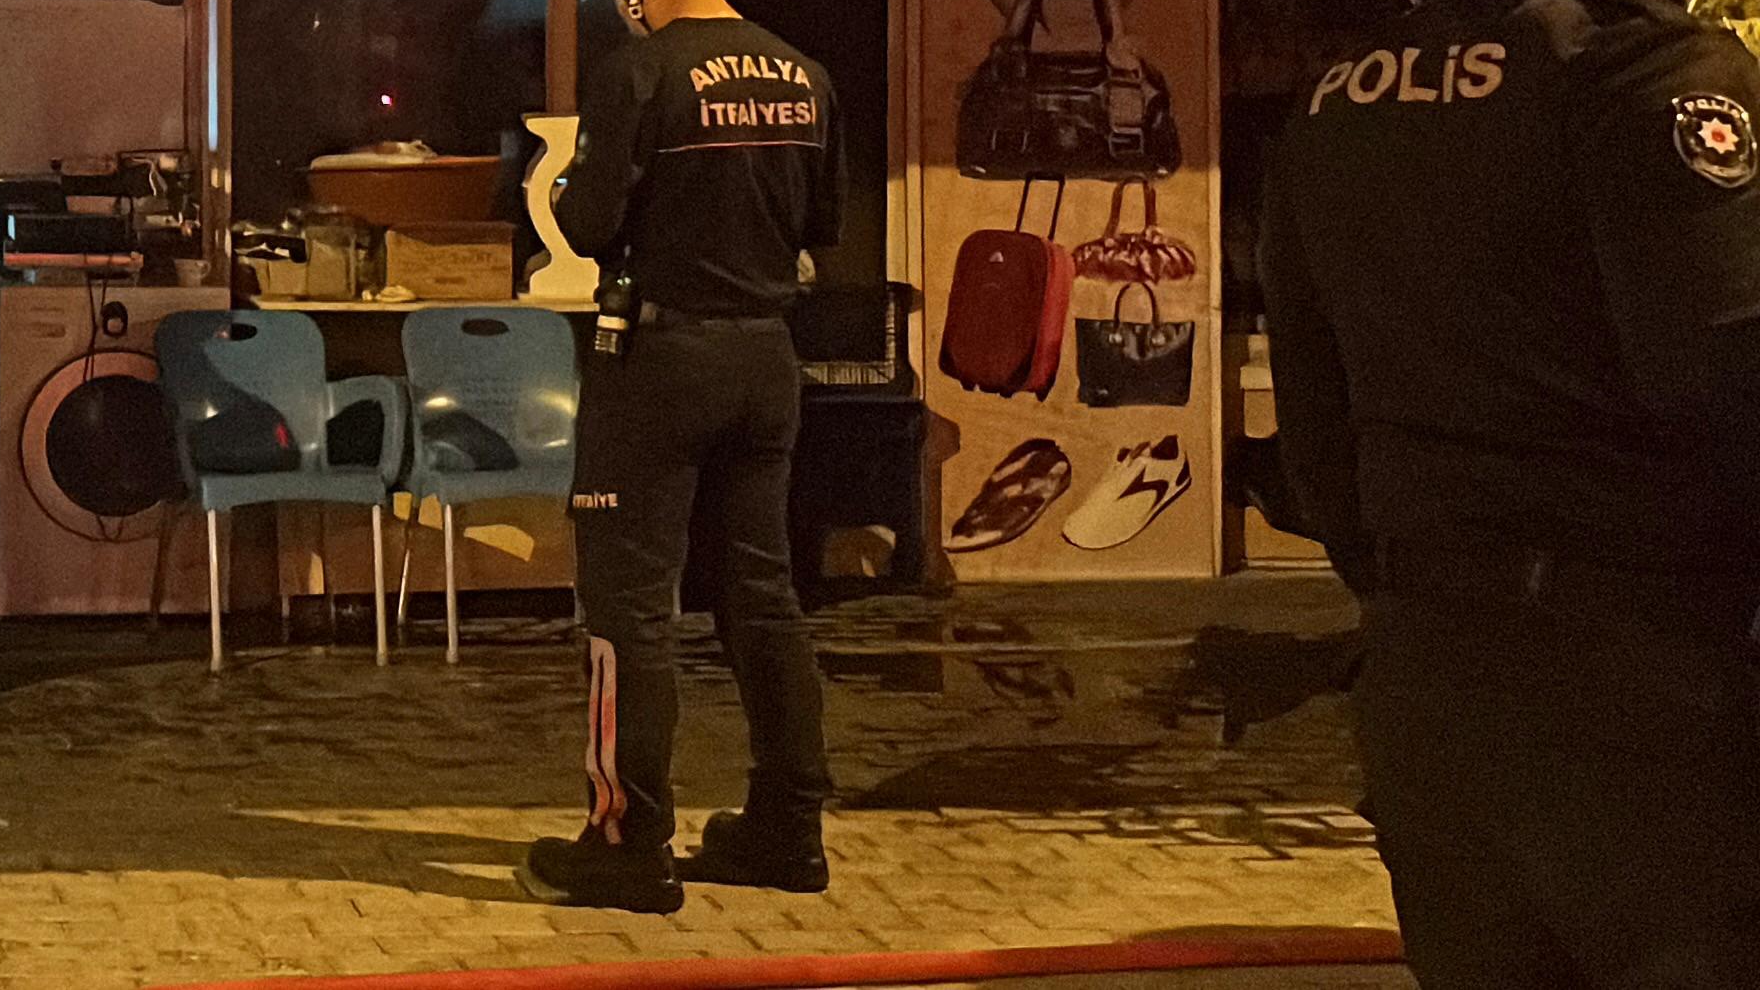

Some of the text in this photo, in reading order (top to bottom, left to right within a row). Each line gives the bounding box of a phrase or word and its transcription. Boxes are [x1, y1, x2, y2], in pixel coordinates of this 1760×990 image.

[690, 55, 812, 89] ANTALYA
[1309, 43, 1507, 116] POLİS
[700, 96, 817, 127] İTFAİYESİ
